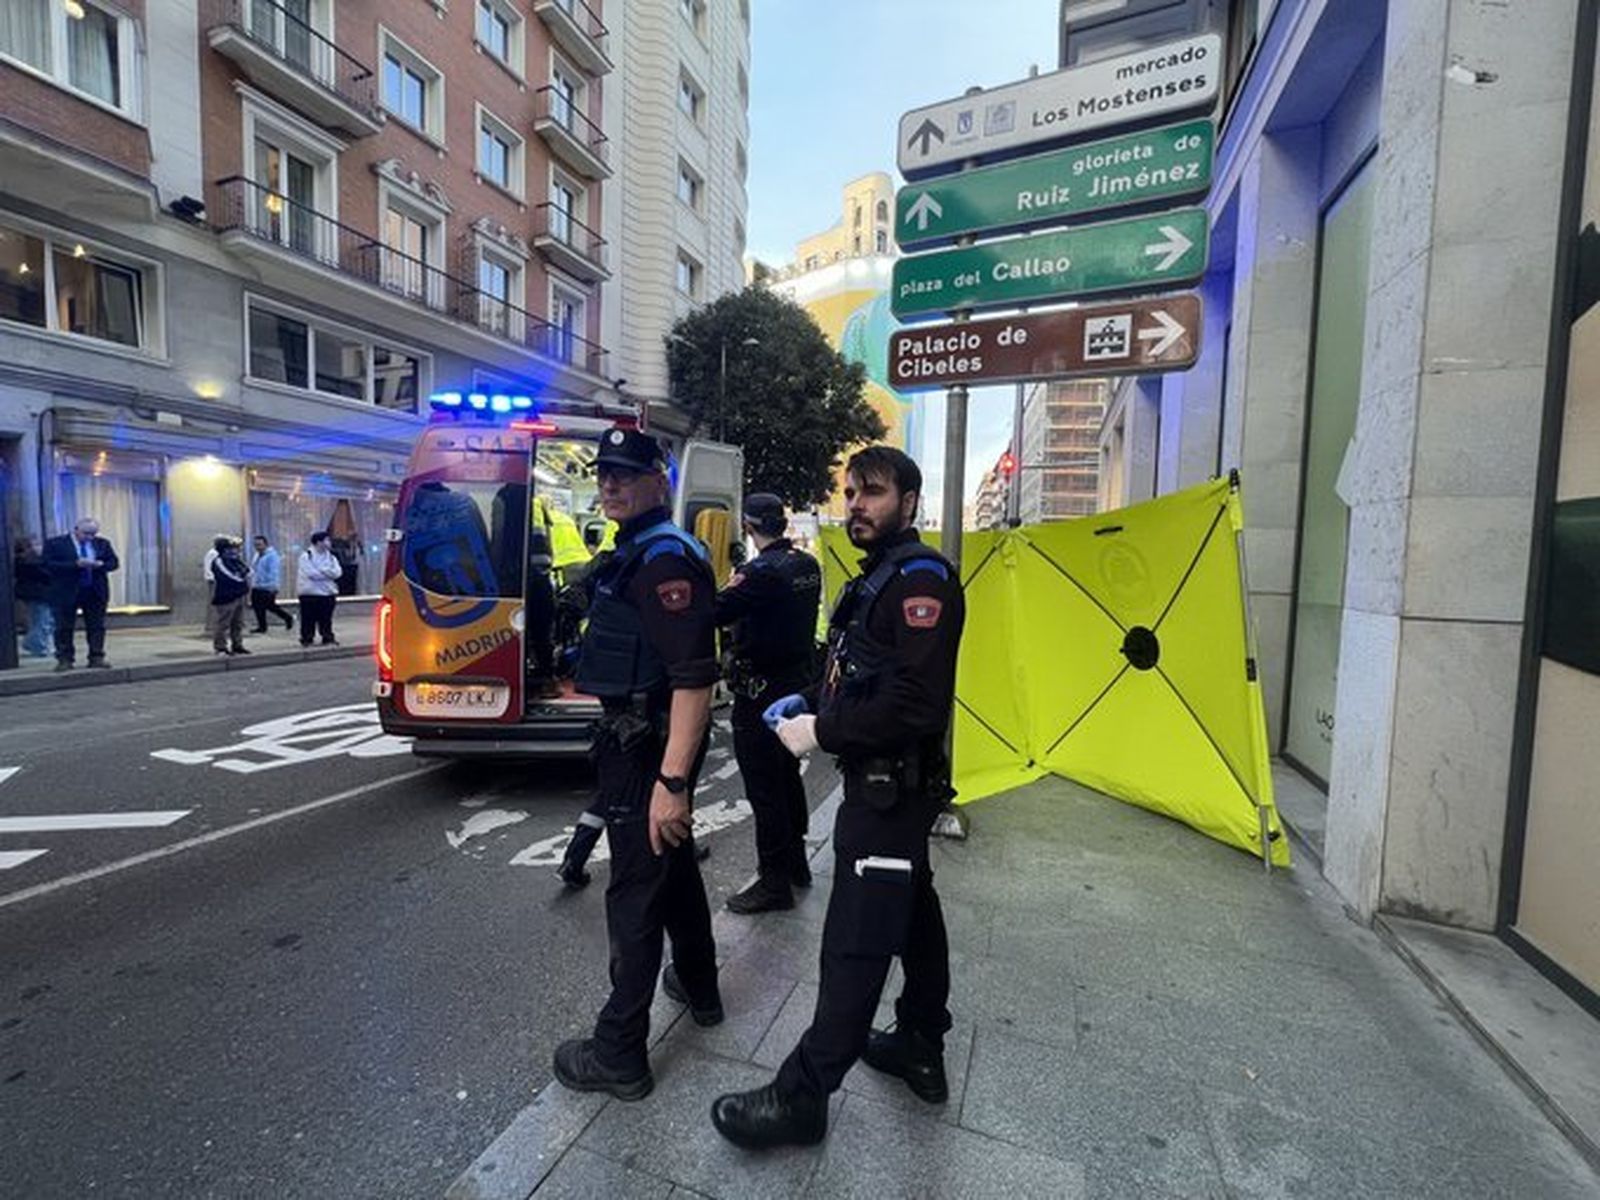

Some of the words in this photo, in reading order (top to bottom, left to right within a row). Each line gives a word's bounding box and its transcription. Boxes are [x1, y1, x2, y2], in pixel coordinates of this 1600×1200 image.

[1116, 46, 1207, 80] mercado
[1032, 107, 1069, 127] Los
[1077, 74, 1206, 117] Mostenses
[1072, 144, 1153, 176] glorieta
[1174, 134, 1202, 151] de
[1017, 185, 1070, 211] Ruiz
[1088, 162, 1199, 197] Jiménez
[900, 278, 943, 298] plaza
[953, 271, 980, 288] del
[992, 257, 1070, 281] Callao
[899, 332, 981, 357] Palacio
[996, 326, 1027, 346] de
[897, 354, 983, 378] Cibeles
[435, 627, 513, 667] MADRID
